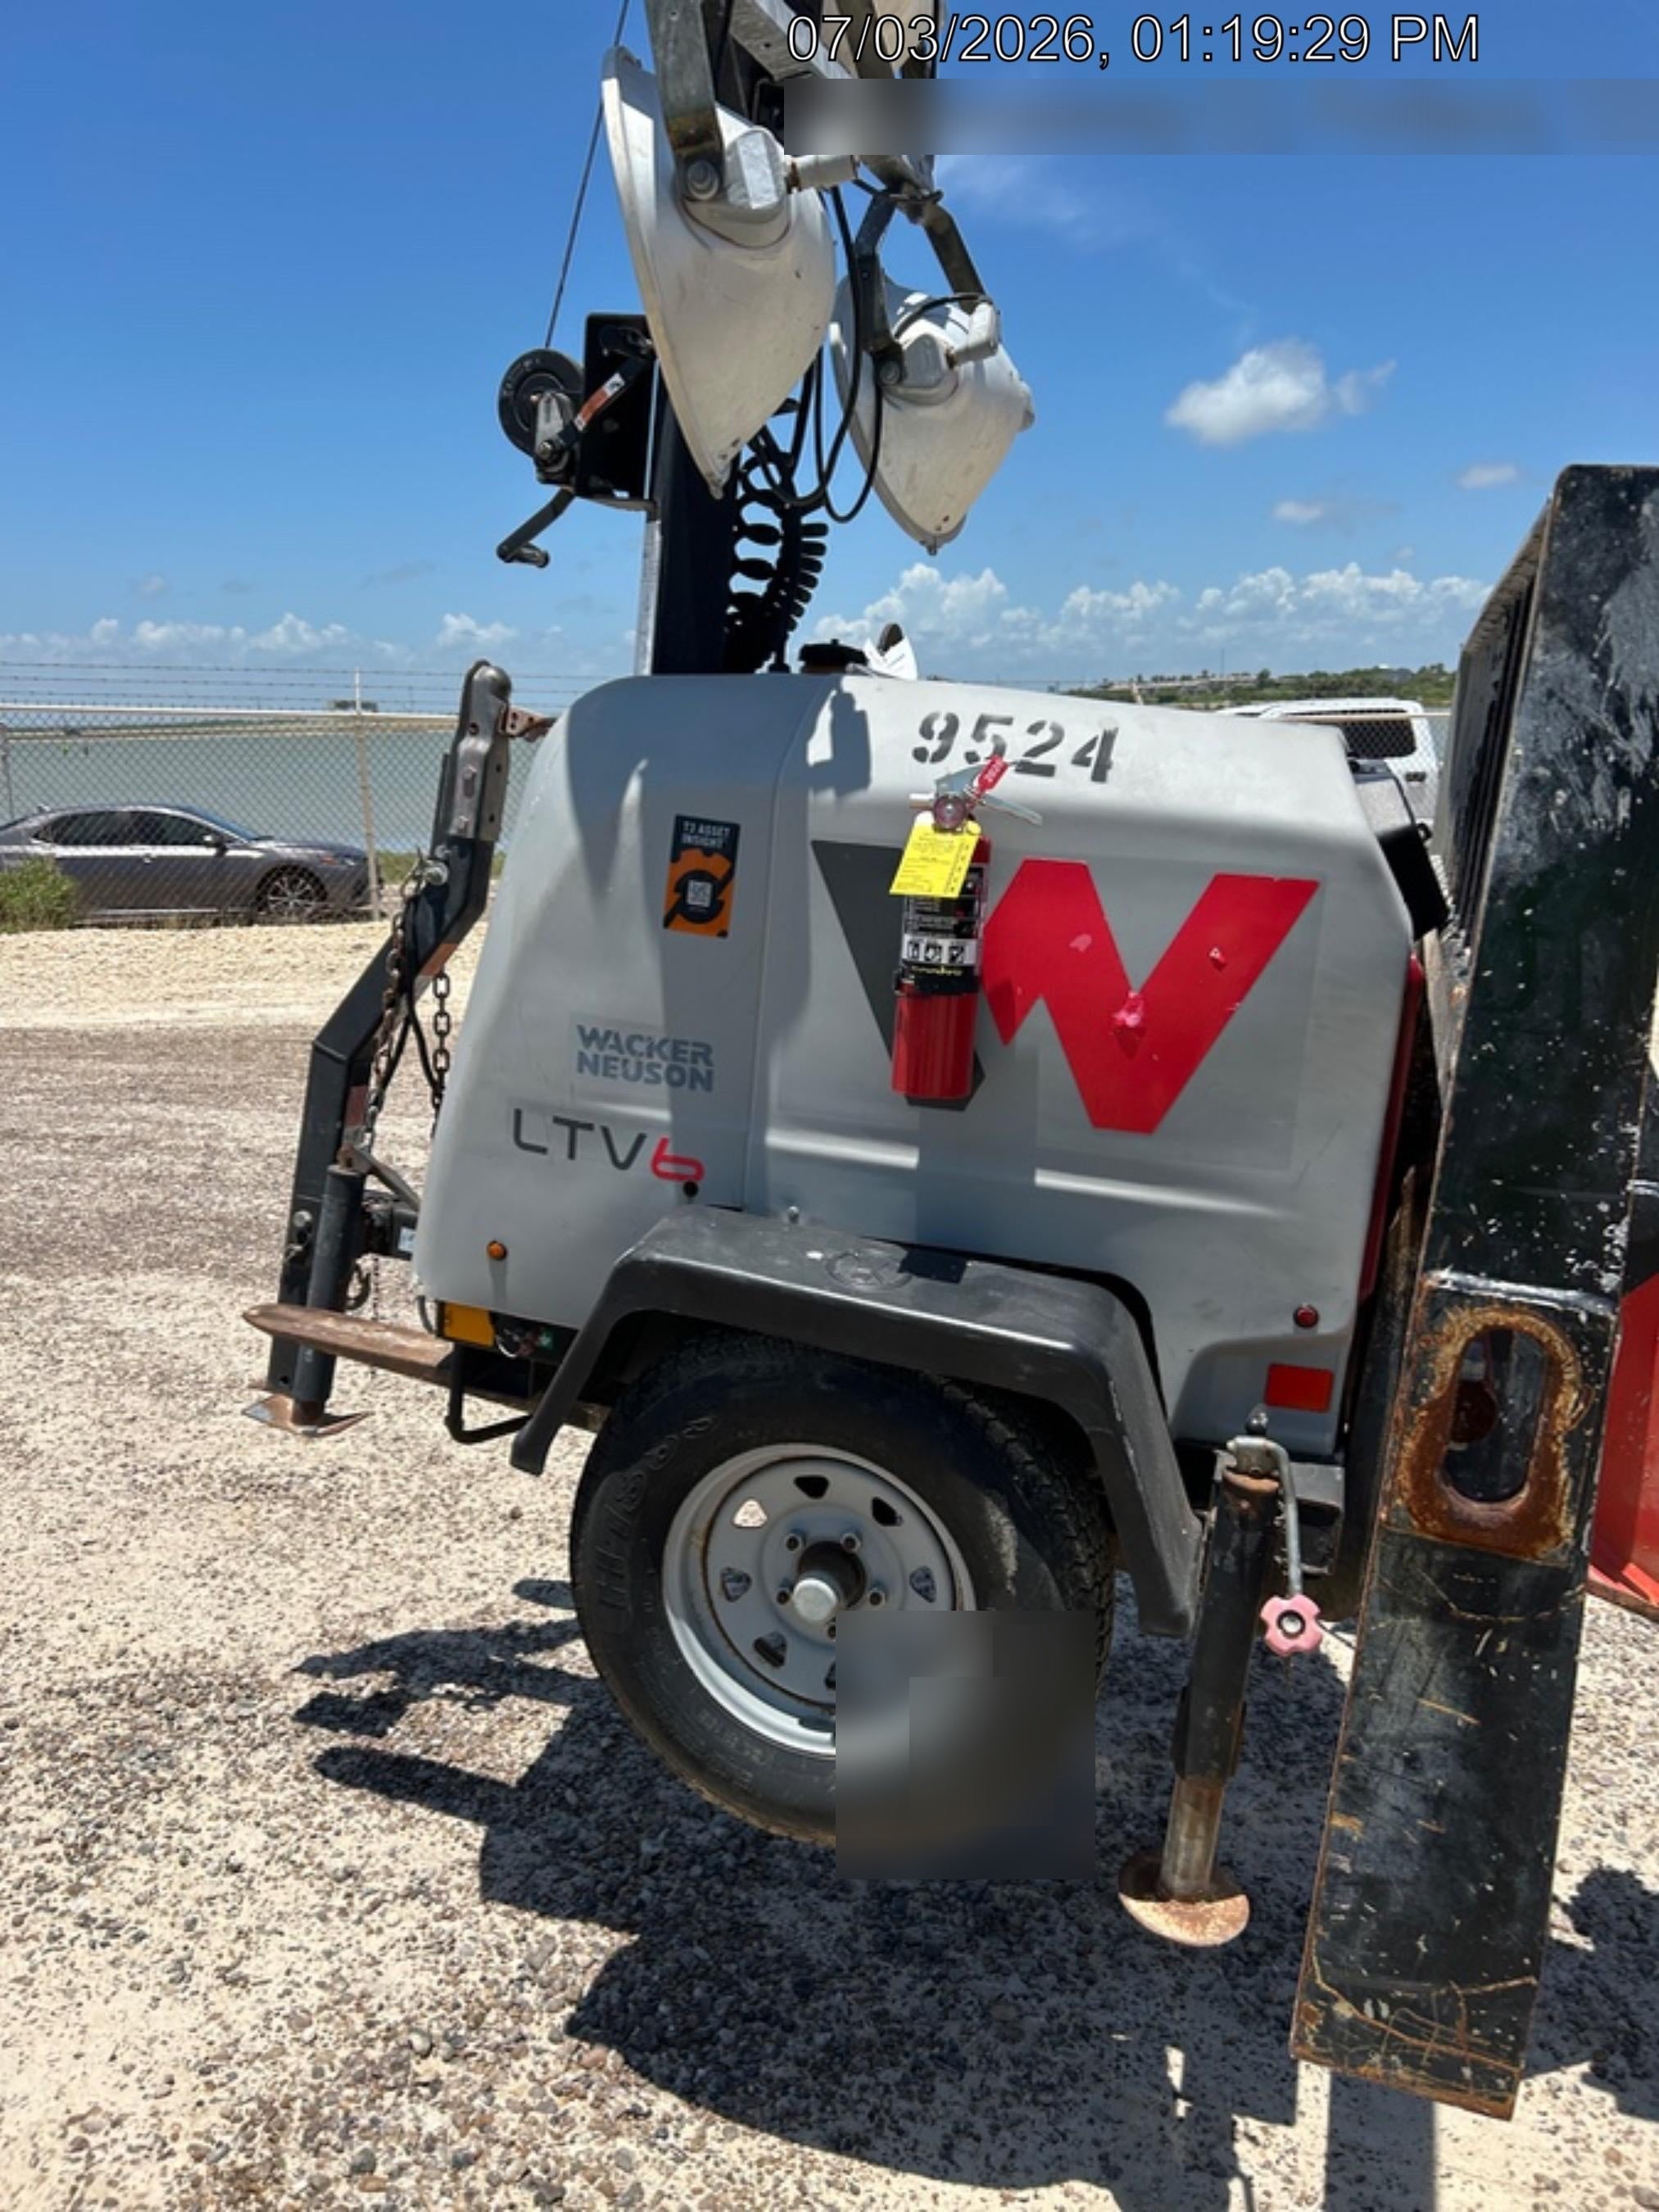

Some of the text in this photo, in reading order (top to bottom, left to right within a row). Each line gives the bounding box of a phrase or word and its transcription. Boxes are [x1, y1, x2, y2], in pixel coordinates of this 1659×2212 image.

[912, 712, 1119, 783] 9524
[576, 1024, 714, 1066] WACKER
[576, 1051, 714, 1092] NEUSON
[514, 1108, 705, 1182] LTV6
